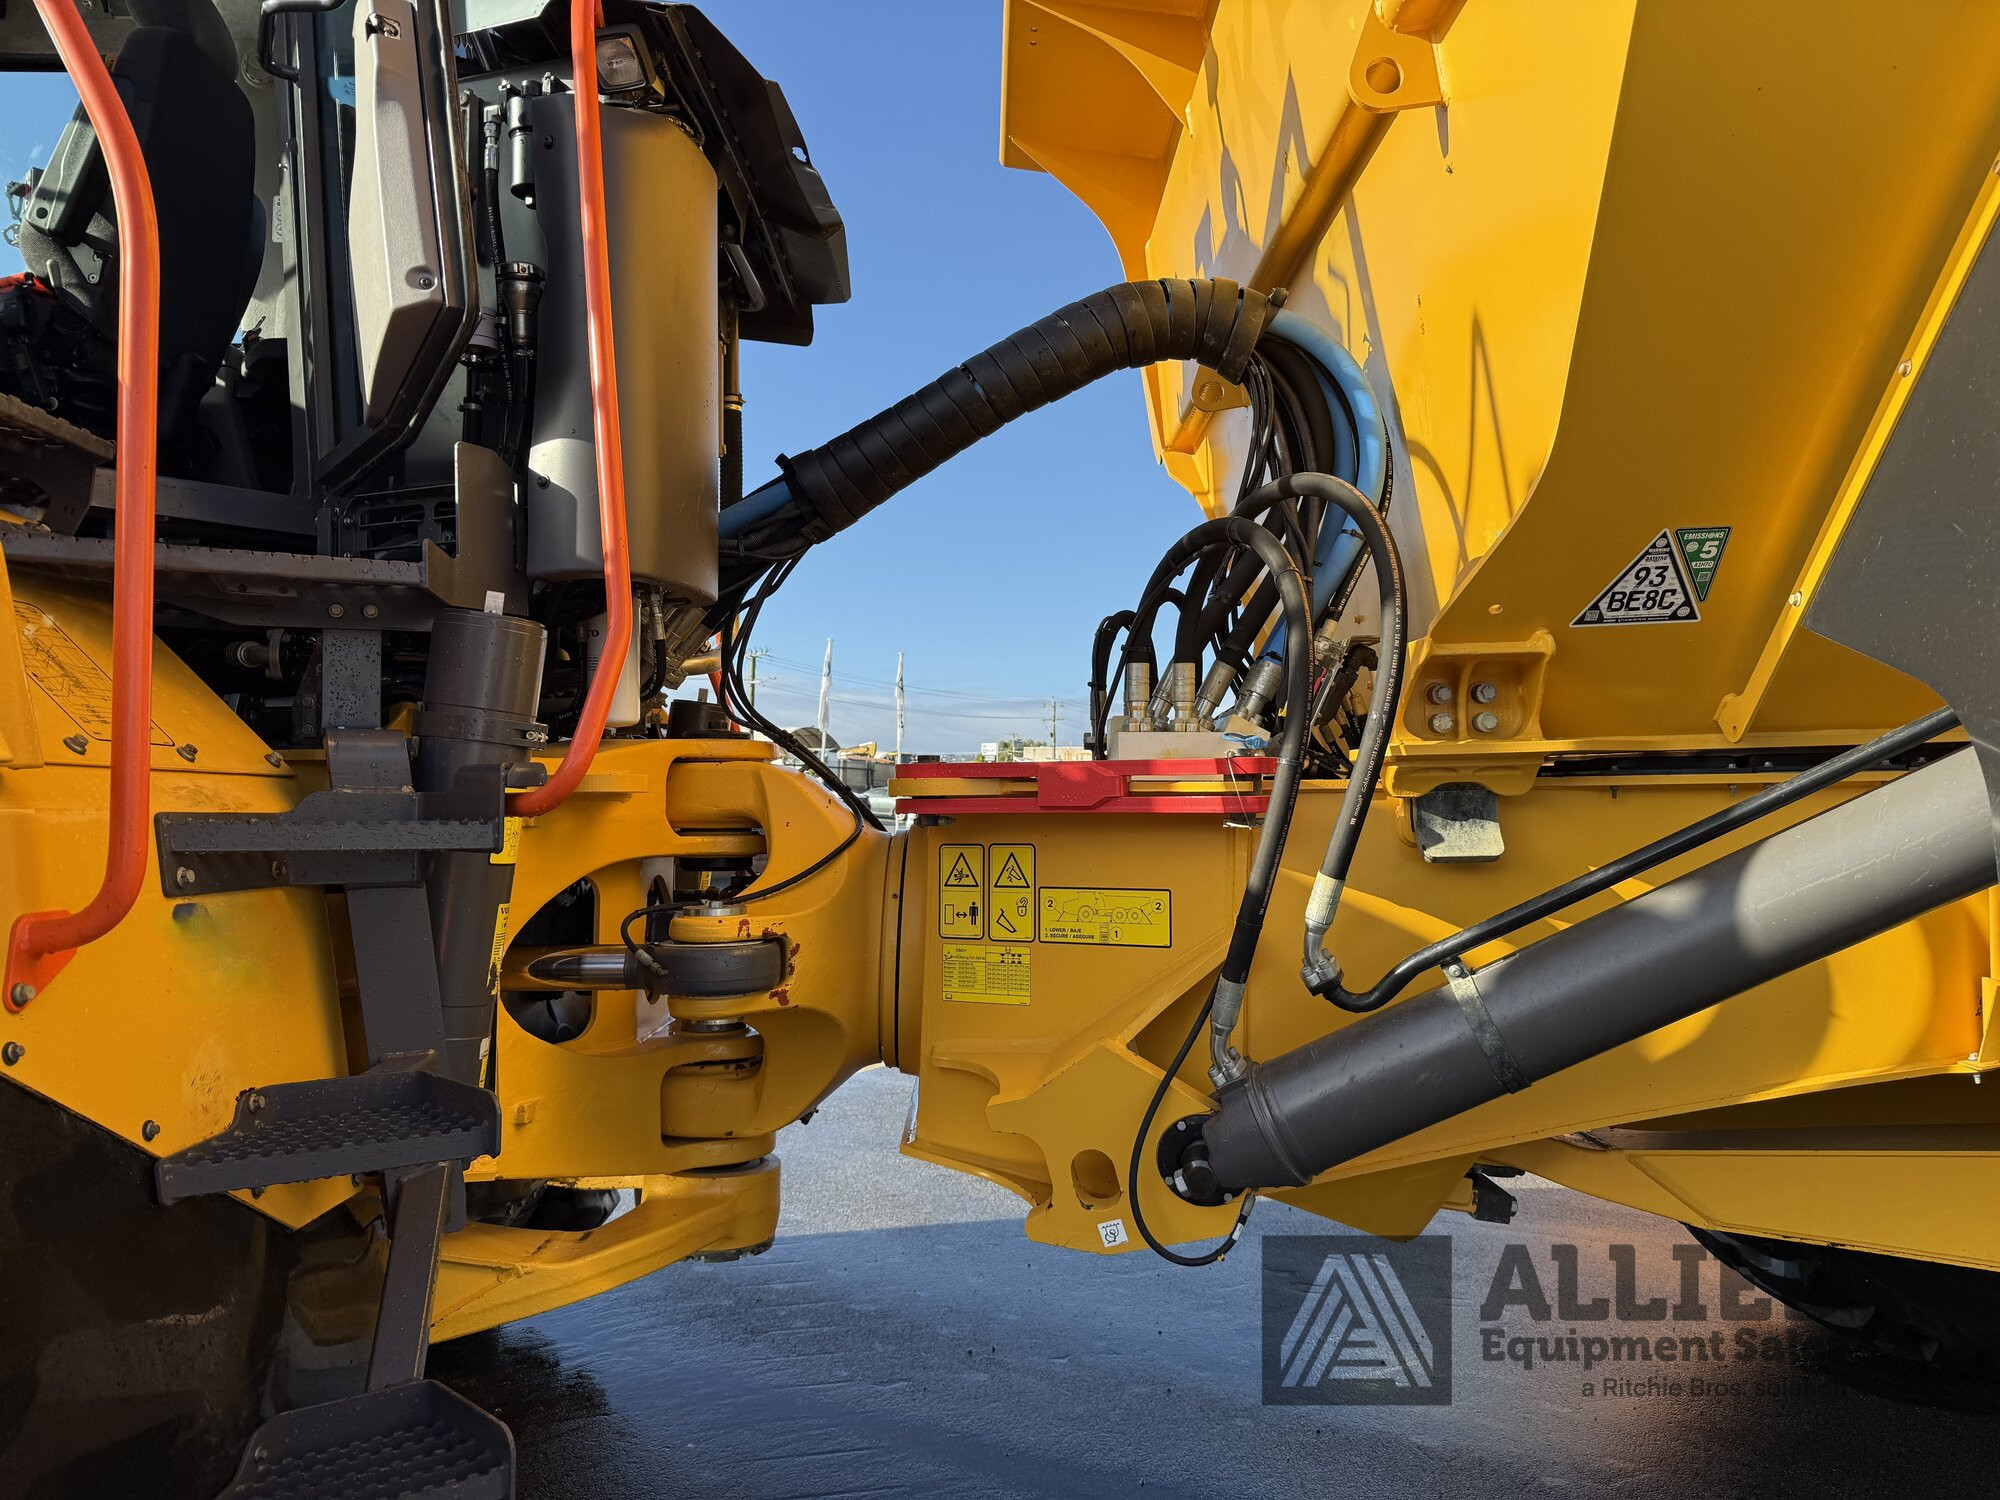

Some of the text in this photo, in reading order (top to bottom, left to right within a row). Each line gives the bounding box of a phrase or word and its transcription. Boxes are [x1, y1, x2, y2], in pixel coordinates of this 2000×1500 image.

[1699, 541, 1719, 559] 5
[1634, 566, 1669, 588] 93
[1606, 589, 1677, 612] BE8C
[1047, 900, 1053, 908] 2
[1155, 902, 1162, 910] 2
[1114, 930, 1118, 938] 1
